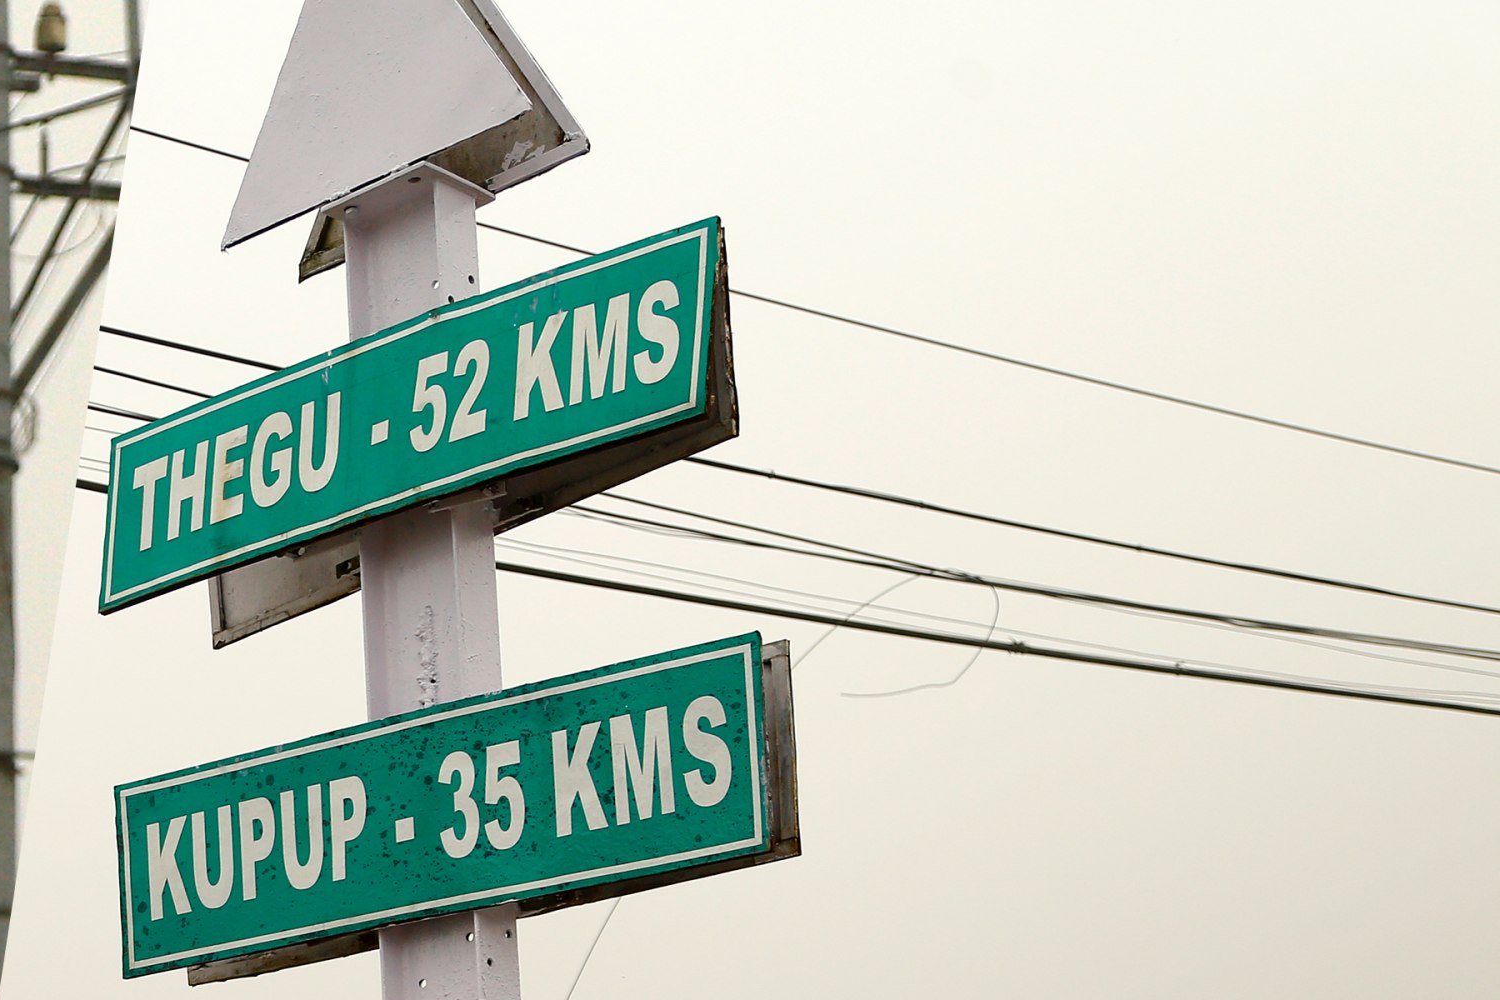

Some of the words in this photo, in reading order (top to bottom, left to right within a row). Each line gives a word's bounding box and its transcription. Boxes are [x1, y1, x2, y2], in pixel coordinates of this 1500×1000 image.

[131, 390, 342, 553] THEGU
[369, 418, 391, 447] -
[408, 338, 491, 454] 52
[512, 278, 681, 423] KMS
[145, 774, 368, 922] KUPUP
[393, 815, 416, 844] -
[436, 738, 527, 860] 35
[550, 694, 733, 839] KMS
